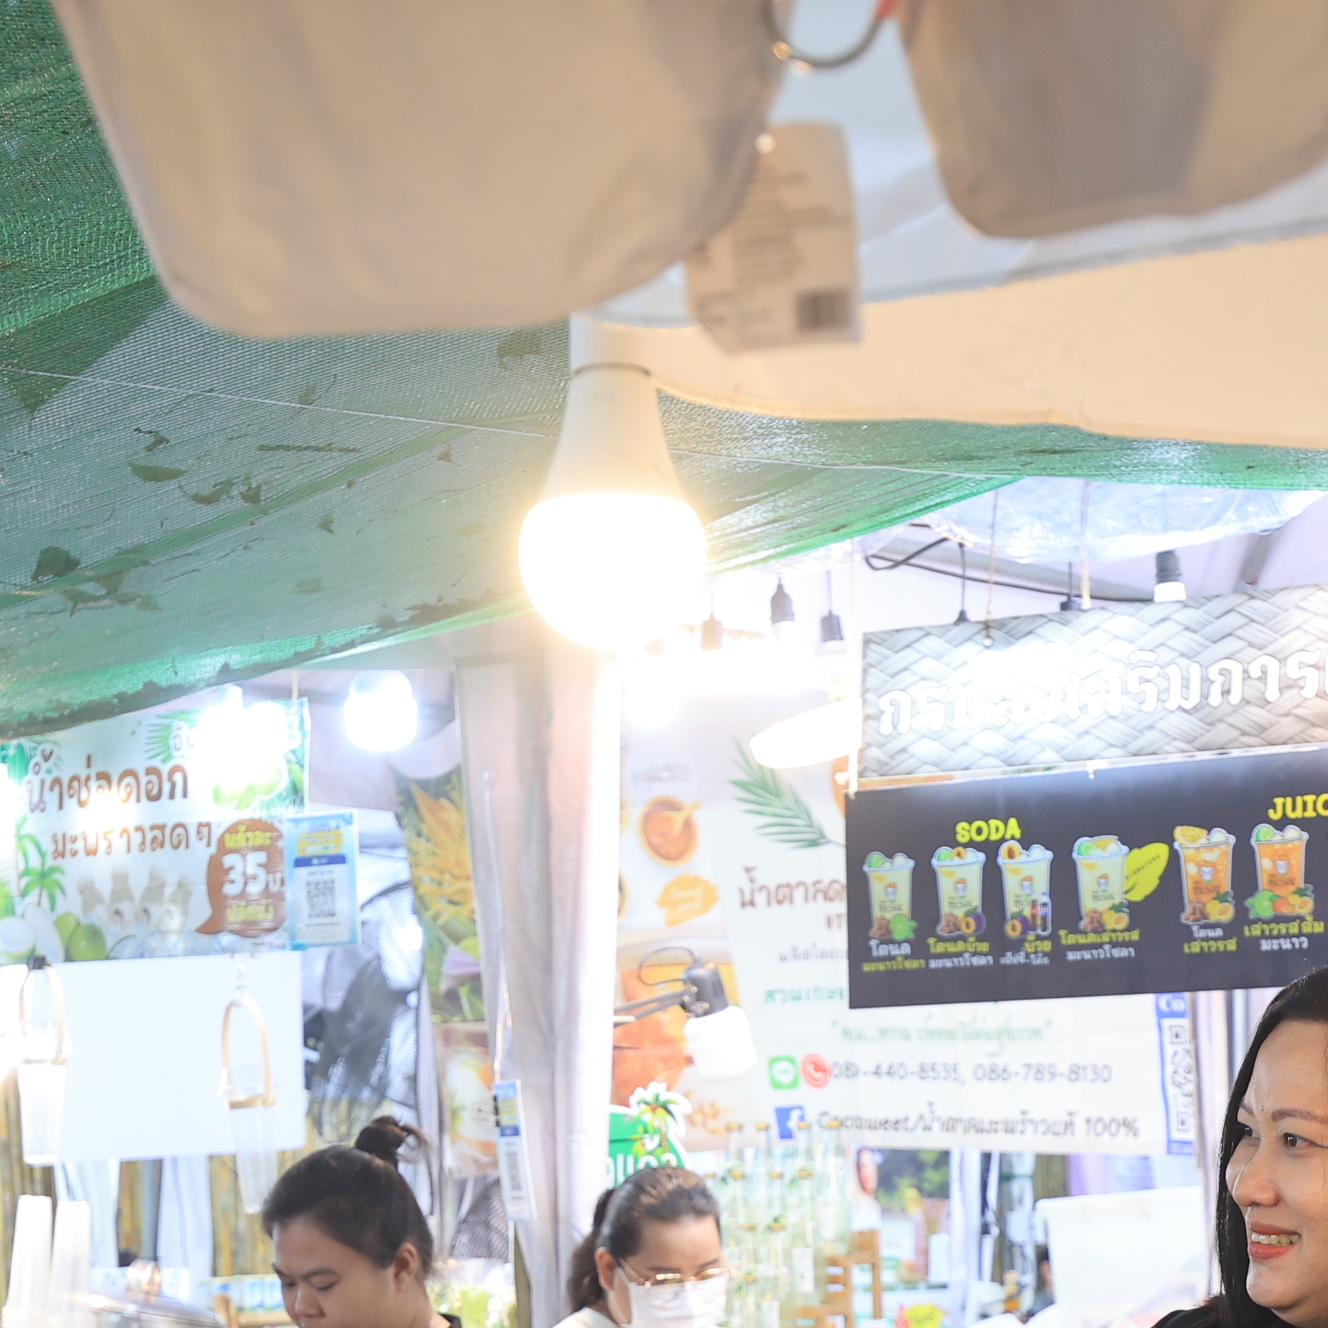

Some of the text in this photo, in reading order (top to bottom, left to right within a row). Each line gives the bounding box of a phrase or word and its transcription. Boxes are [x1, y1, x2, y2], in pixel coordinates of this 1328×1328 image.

[51, 821, 212, 861] มะพราวสดๆ
[955, 817, 1022, 843] SODA
[221, 850, 269, 896] 35
[1259, 935, 1309, 952] มะนาว
[1084, 1116, 1140, 1138] 100%
